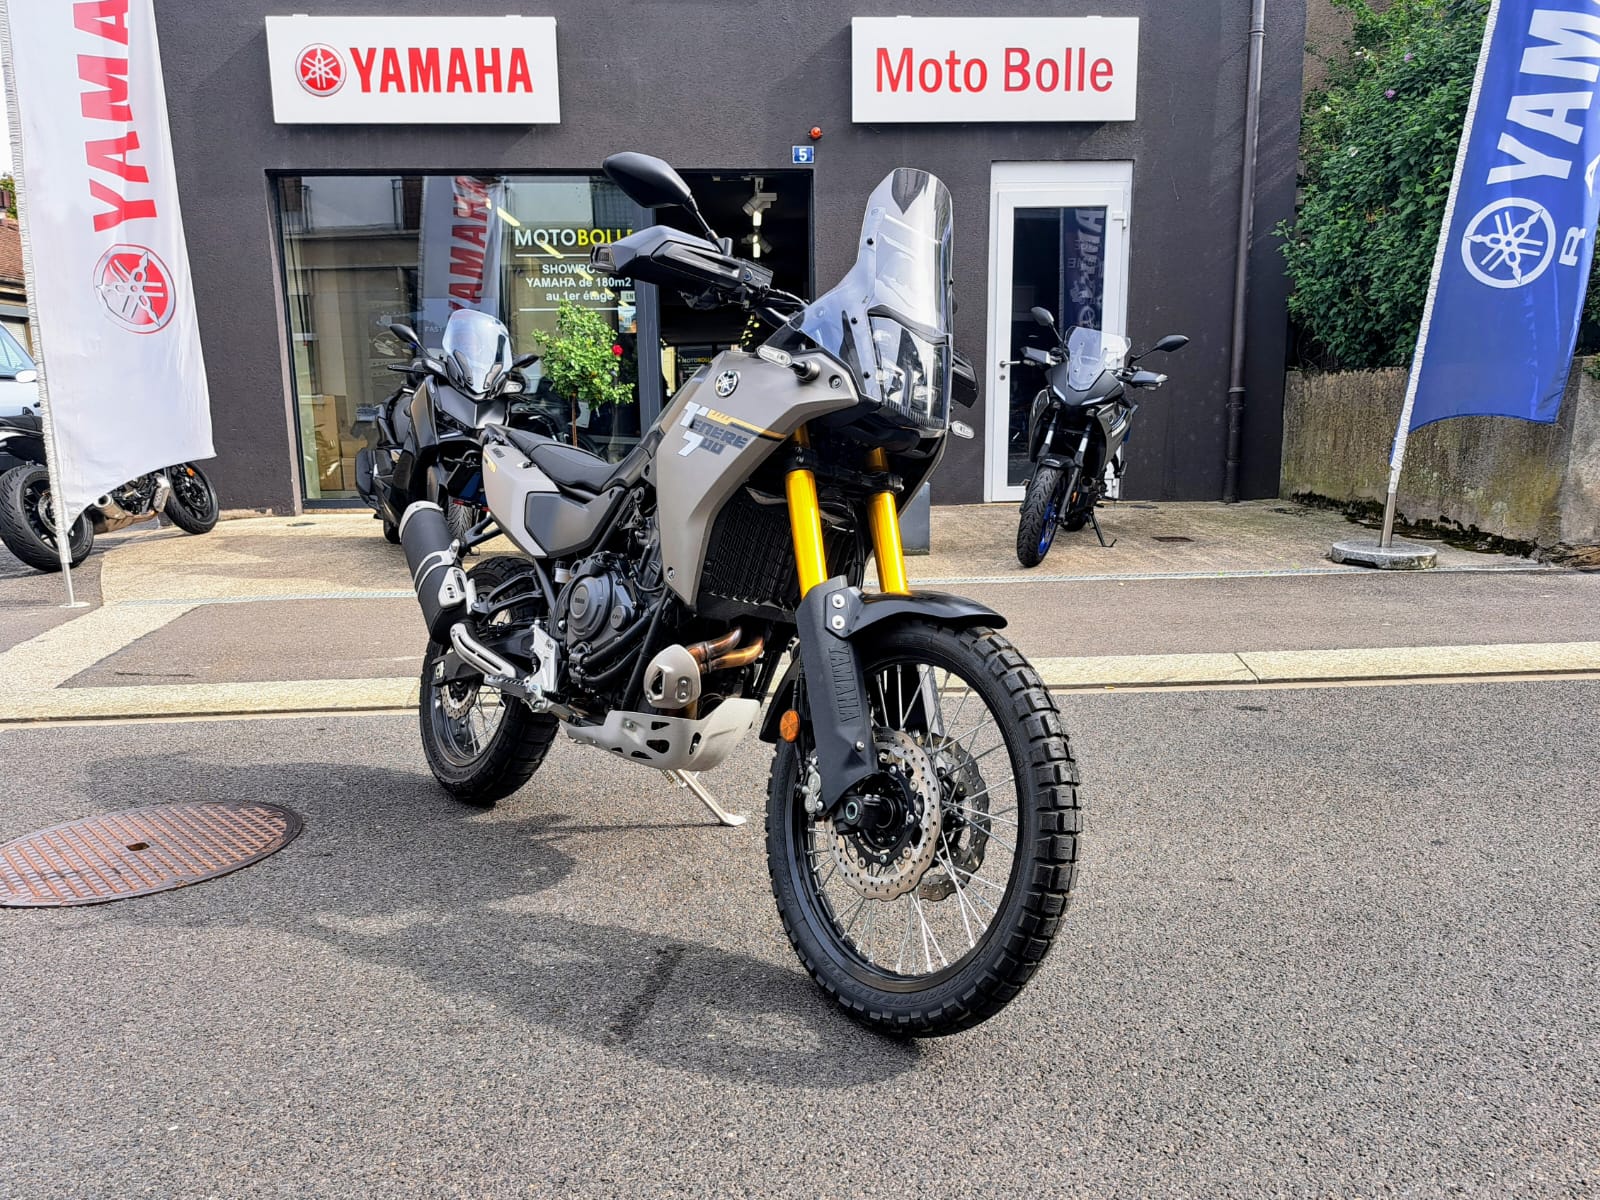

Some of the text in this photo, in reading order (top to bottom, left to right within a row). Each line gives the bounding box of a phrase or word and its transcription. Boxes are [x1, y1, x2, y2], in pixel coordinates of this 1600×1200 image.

[349, 47, 533, 93] YAMAHA
[875, 47, 1114, 93] Moto Bolle
[1486, 0, 1600, 185] YAM
[798, 148, 808, 162] 5
[526, 277, 632, 288] YAMAHA de 180m2
[546, 293, 559, 301] au
[563, 291, 580, 301] 1er
[828, 642, 861, 723] YAMAHA
